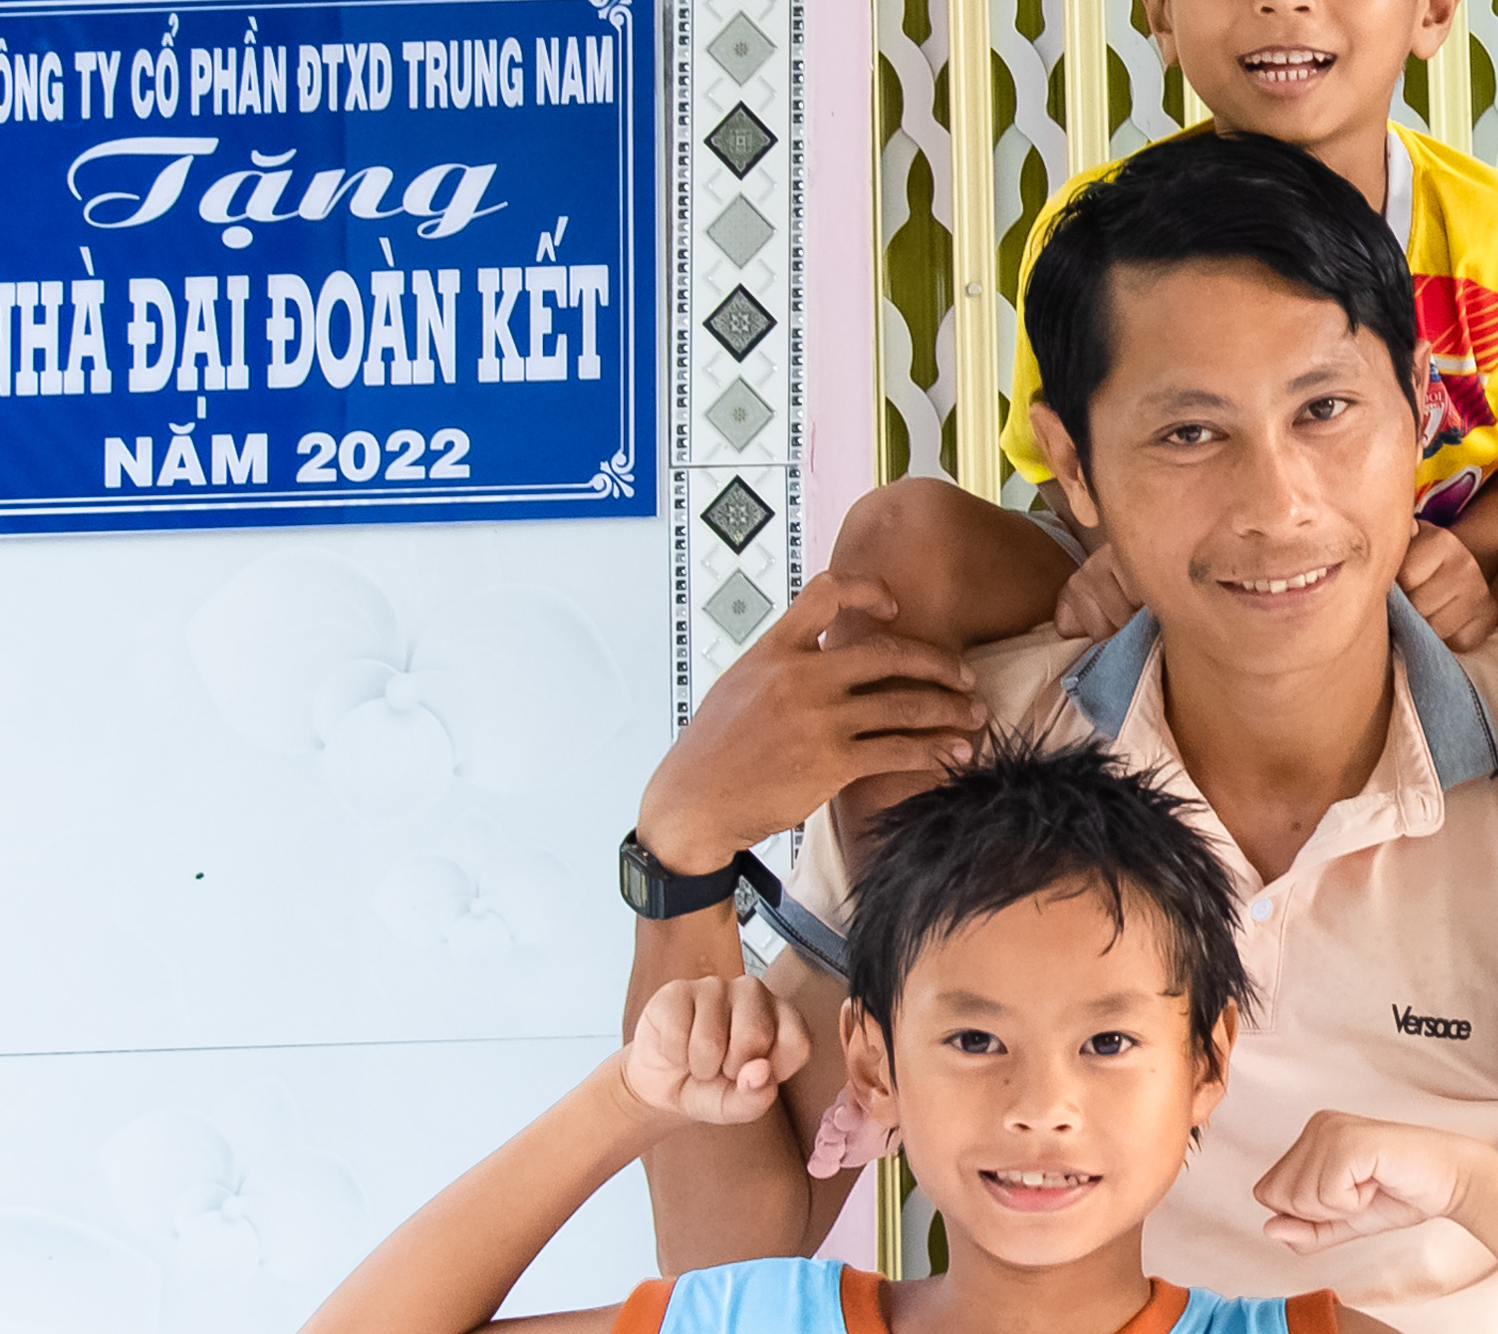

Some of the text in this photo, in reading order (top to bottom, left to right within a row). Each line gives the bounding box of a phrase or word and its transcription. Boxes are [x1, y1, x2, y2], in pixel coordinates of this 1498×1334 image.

[74, 50, 121, 120] TY
[130, 12, 180, 119] CỔ
[190, 16, 287, 116] PHẦN
[296, 42, 393, 113] ĐTXD
[402, 37, 524, 110] TRUNG
[535, 35, 614, 106] NAM
[67, 136, 508, 249] Tặng
[127, 275, 249, 419] ĐẠI
[266, 237, 461, 389] ĐOÀN
[477, 215, 609, 383] KẾT
[104, 422, 470, 489] NĂM 2022
[1392, 1003, 1472, 1040] Versace
